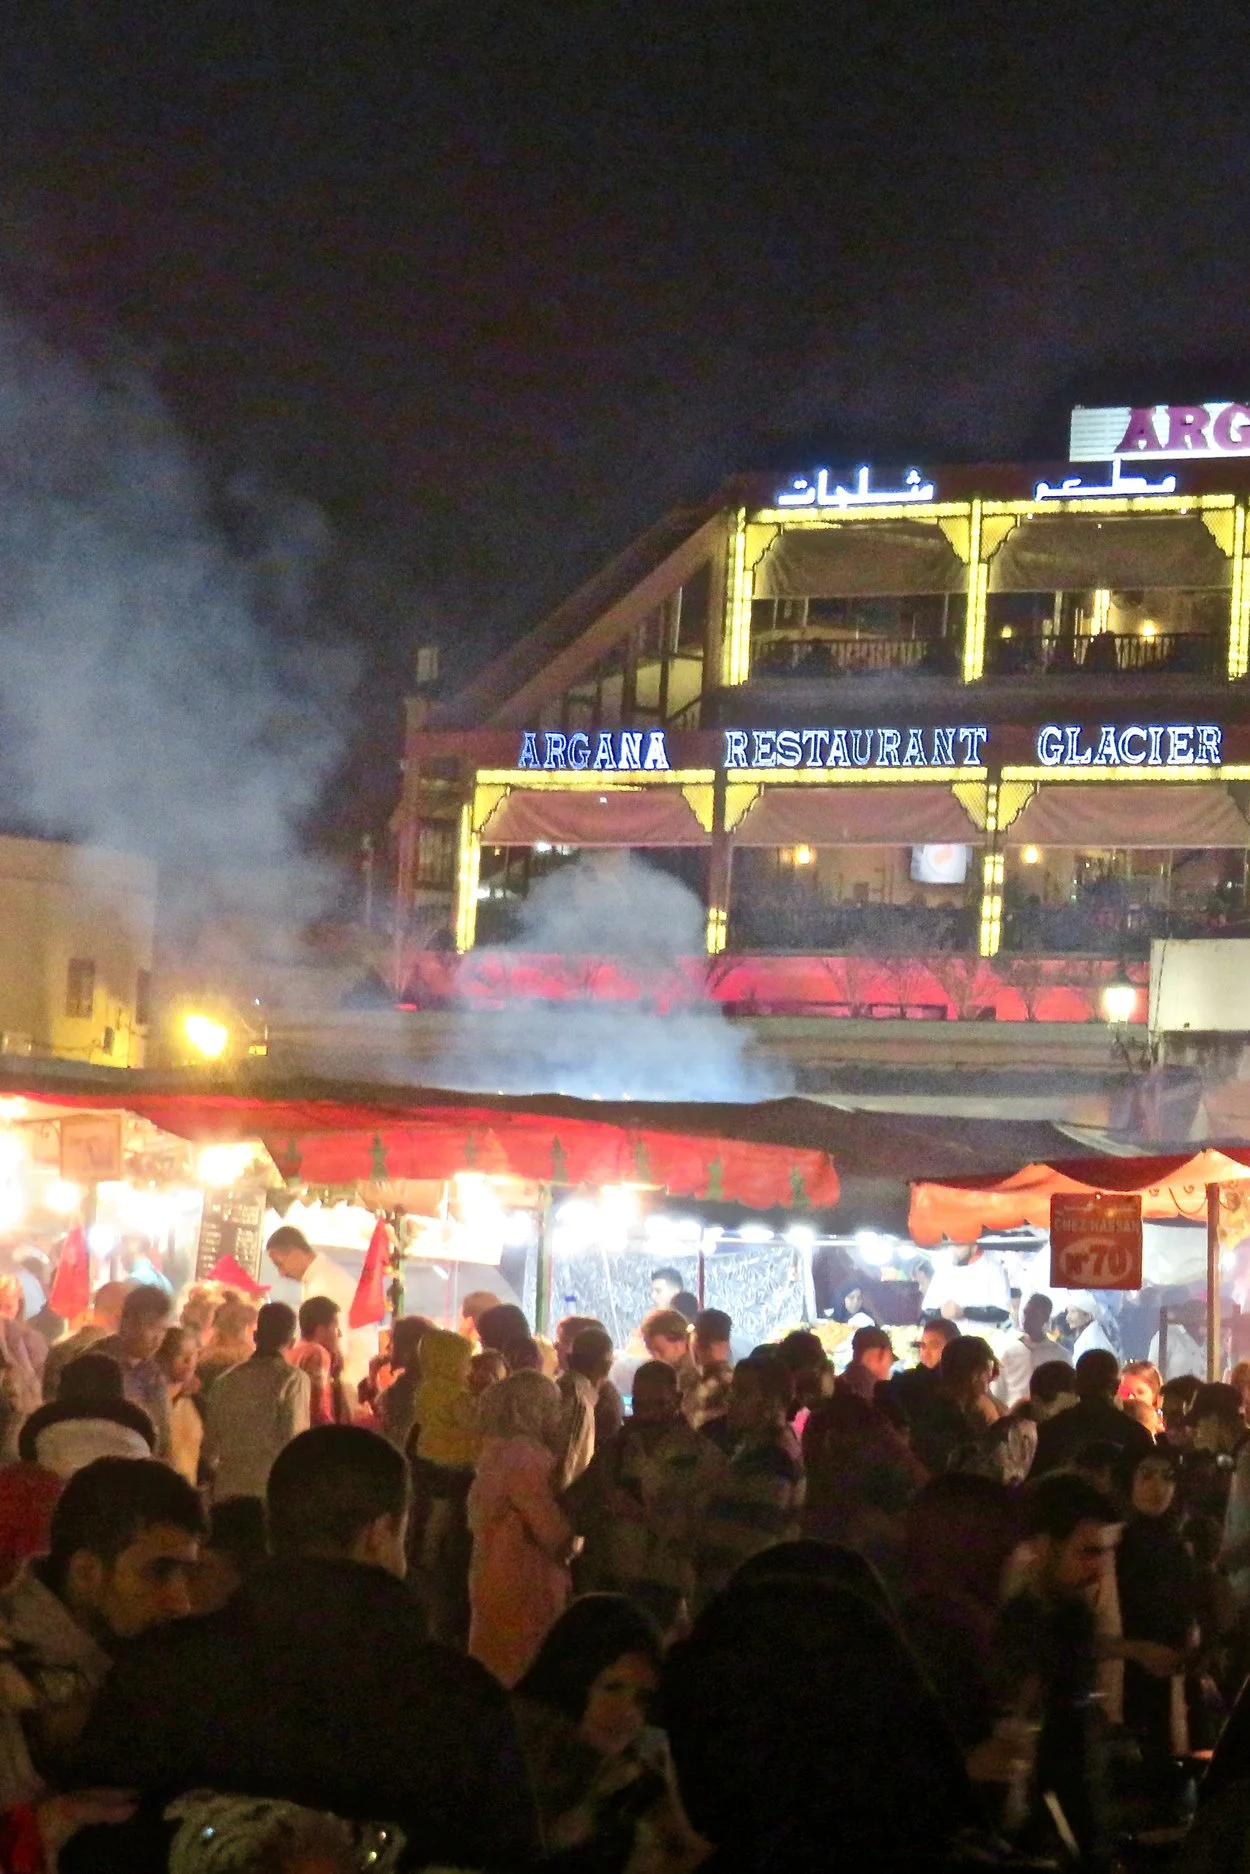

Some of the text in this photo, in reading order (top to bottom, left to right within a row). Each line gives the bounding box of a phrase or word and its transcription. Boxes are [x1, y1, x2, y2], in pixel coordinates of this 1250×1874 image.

[517, 726, 1222, 770] ARGANA RESTAURANT GLACIER
